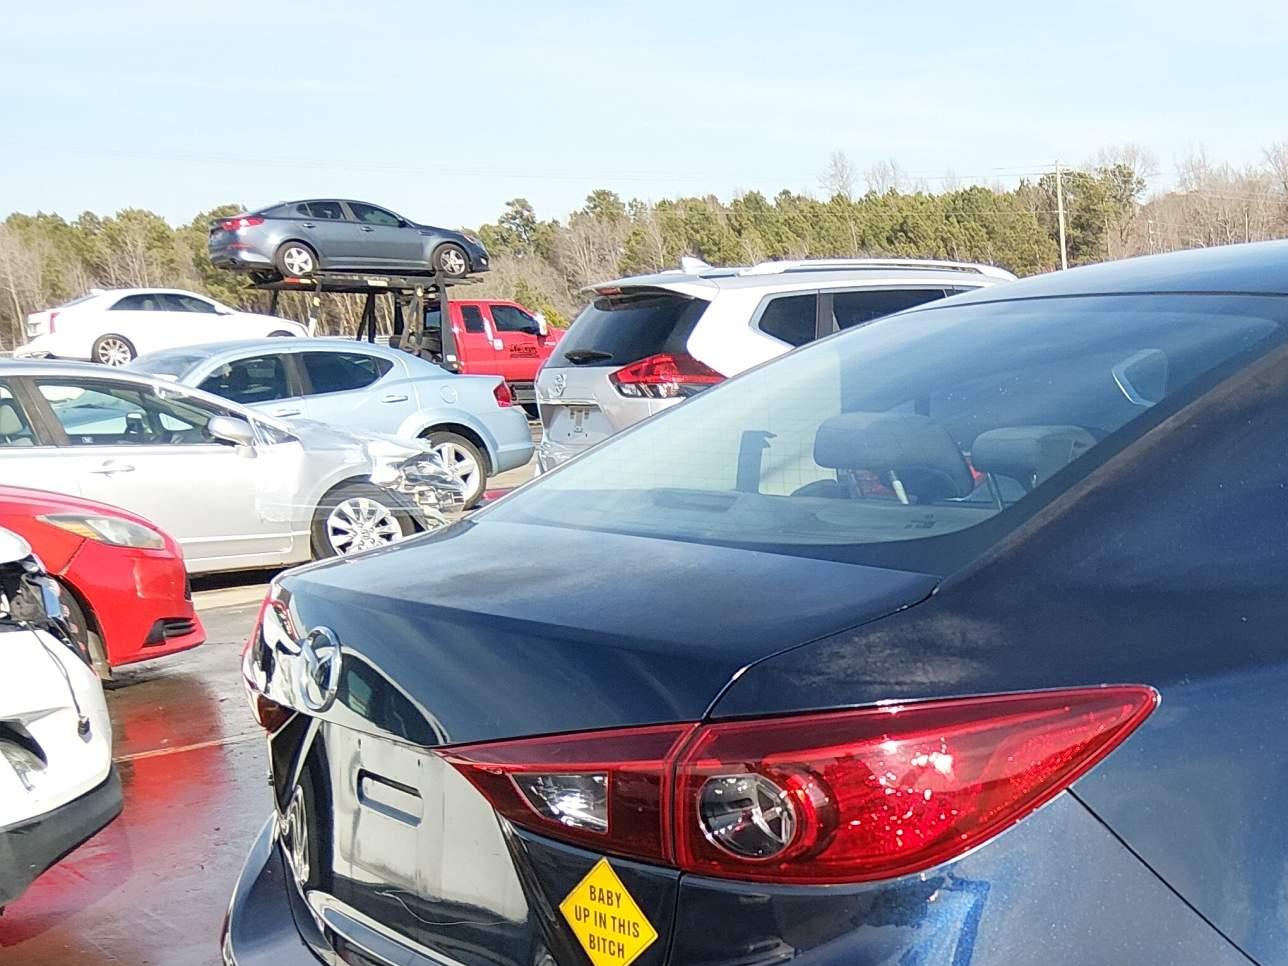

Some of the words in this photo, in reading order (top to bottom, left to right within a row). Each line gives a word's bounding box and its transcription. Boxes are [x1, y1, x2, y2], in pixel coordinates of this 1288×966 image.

[589, 885, 622, 909] BABY
[574, 905, 590, 923] UP
[594, 910, 607, 930] IN
[611, 915, 640, 938] THIS
[588, 933, 625, 959] BITCH
